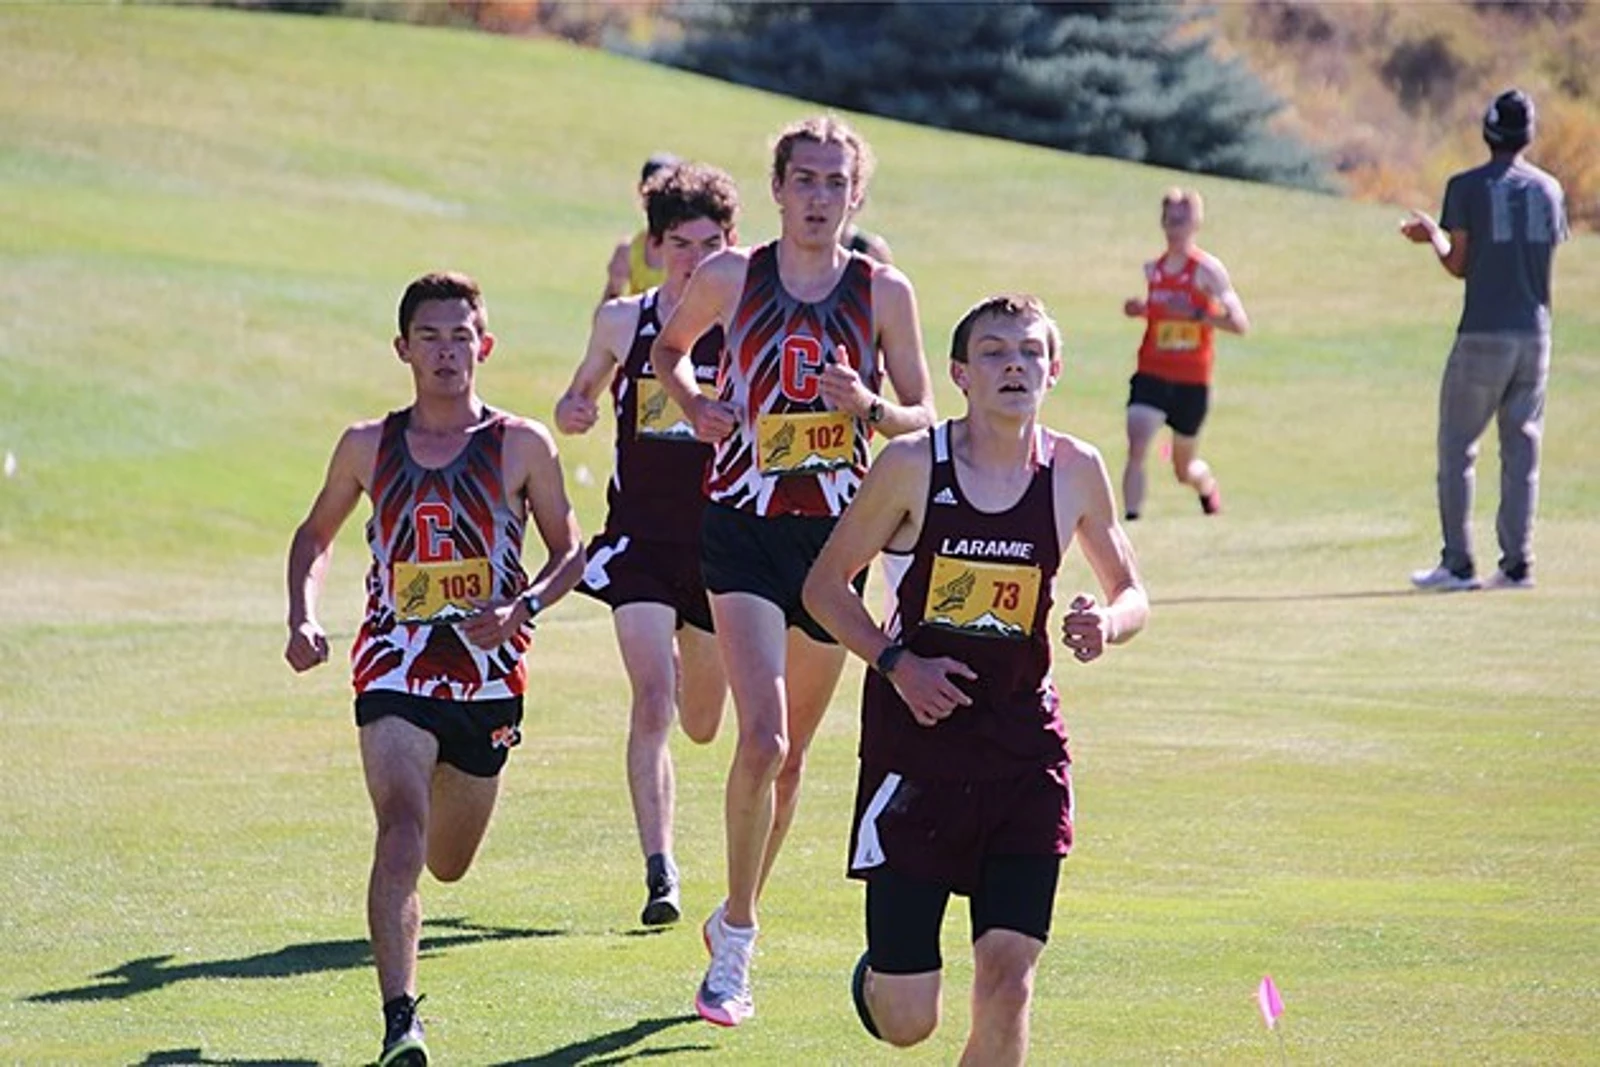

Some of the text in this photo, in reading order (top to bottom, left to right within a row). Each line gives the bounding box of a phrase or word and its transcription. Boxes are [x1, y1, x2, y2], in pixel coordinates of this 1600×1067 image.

[779, 335, 822, 402] C
[805, 423, 845, 451] 102
[414, 502, 455, 563] C
[941, 538, 1034, 559] LARAMIE
[438, 573, 481, 600] 103
[991, 580, 1021, 611] 73
